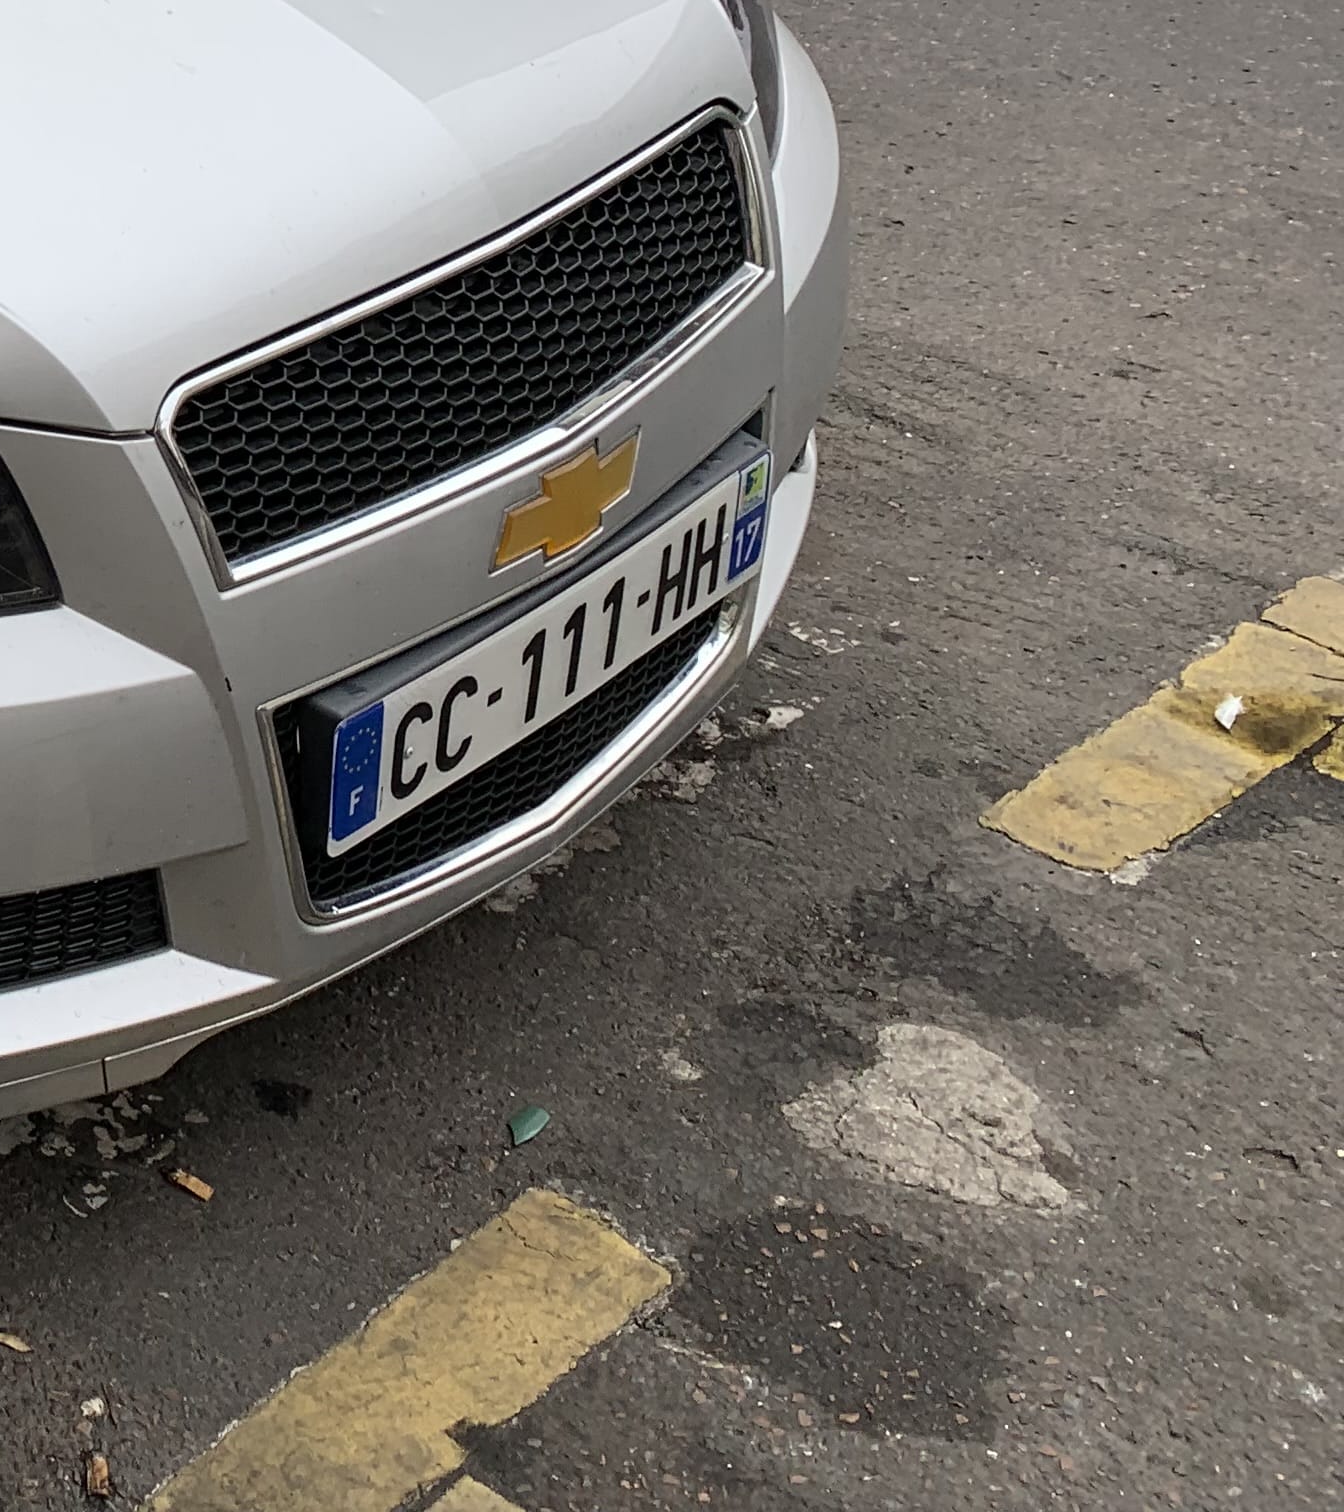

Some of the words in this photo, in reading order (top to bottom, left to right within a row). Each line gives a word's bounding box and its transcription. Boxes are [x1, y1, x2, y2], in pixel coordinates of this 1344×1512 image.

[735, 516, 762, 569] 17
[390, 503, 727, 800] CC-111-HH
[348, 785, 364, 817] F
